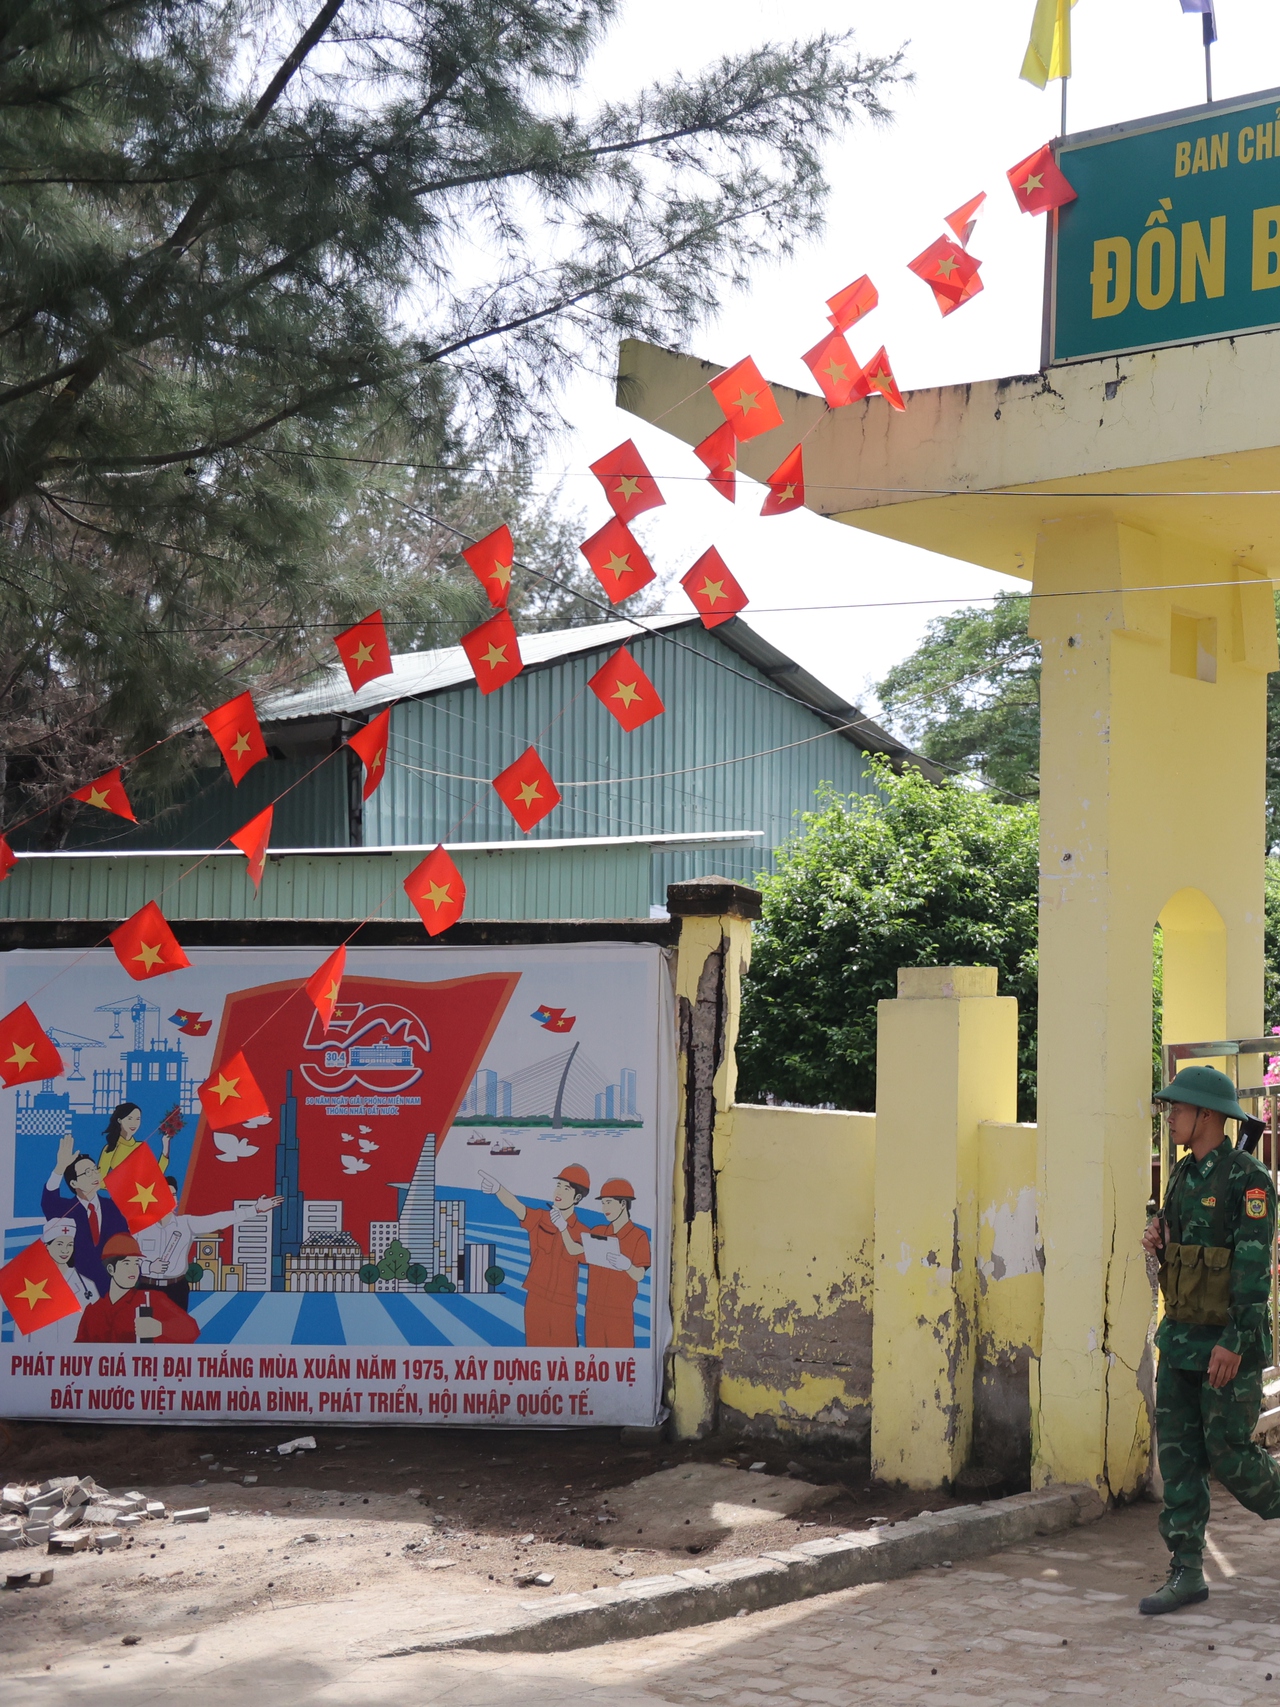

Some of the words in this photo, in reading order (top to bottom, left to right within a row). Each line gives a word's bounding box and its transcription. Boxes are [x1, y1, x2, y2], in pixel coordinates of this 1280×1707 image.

[1174, 134, 1229, 178] BAN
[1090, 197, 1227, 319] ĐỒN
[326, 1052, 345, 1061] 30.4
[306, 1097, 314, 1105] 50
[405, 1097, 421, 1105] NAM
[11, 1351, 55, 1376] PHÁT
[60, 1355, 93, 1377] HUY
[98, 1352, 126, 1377] GIÁ
[132, 1356, 158, 1382] TRỊ
[163, 1356, 192, 1382] ĐẠI
[198, 1349, 253, 1378] THẮNG
[259, 1353, 298, 1379] MÙA
[303, 1354, 350, 1379] XUÂN
[356, 1354, 396, 1379] NĂM
[402, 1359, 449, 1383] 1975,
[454, 1355, 488, 1380] XÂY
[493, 1358, 541, 1385] DỰNG
[546, 1356, 569, 1382] VÀ
[574, 1354, 609, 1382] BẢO
[616, 1356, 636, 1387] VỆ
[50, 1382, 83, 1409] ĐẤT
[88, 1387, 135, 1410] NƯỚC
[140, 1386, 176, 1415] VIỆT
[181, 1390, 221, 1411] NAM
[227, 1386, 261, 1412] HÒA
[267, 1386, 313, 1415] BÌNH,
[319, 1387, 362, 1413] PHÁT
[368, 1384, 422, 1416] TRIỂN,
[429, 1388, 457, 1418] HỘI
[463, 1389, 510, 1418] NHẬP
[517, 1387, 563, 1416] QUỐC
[569, 1387, 594, 1416] TẾ.
